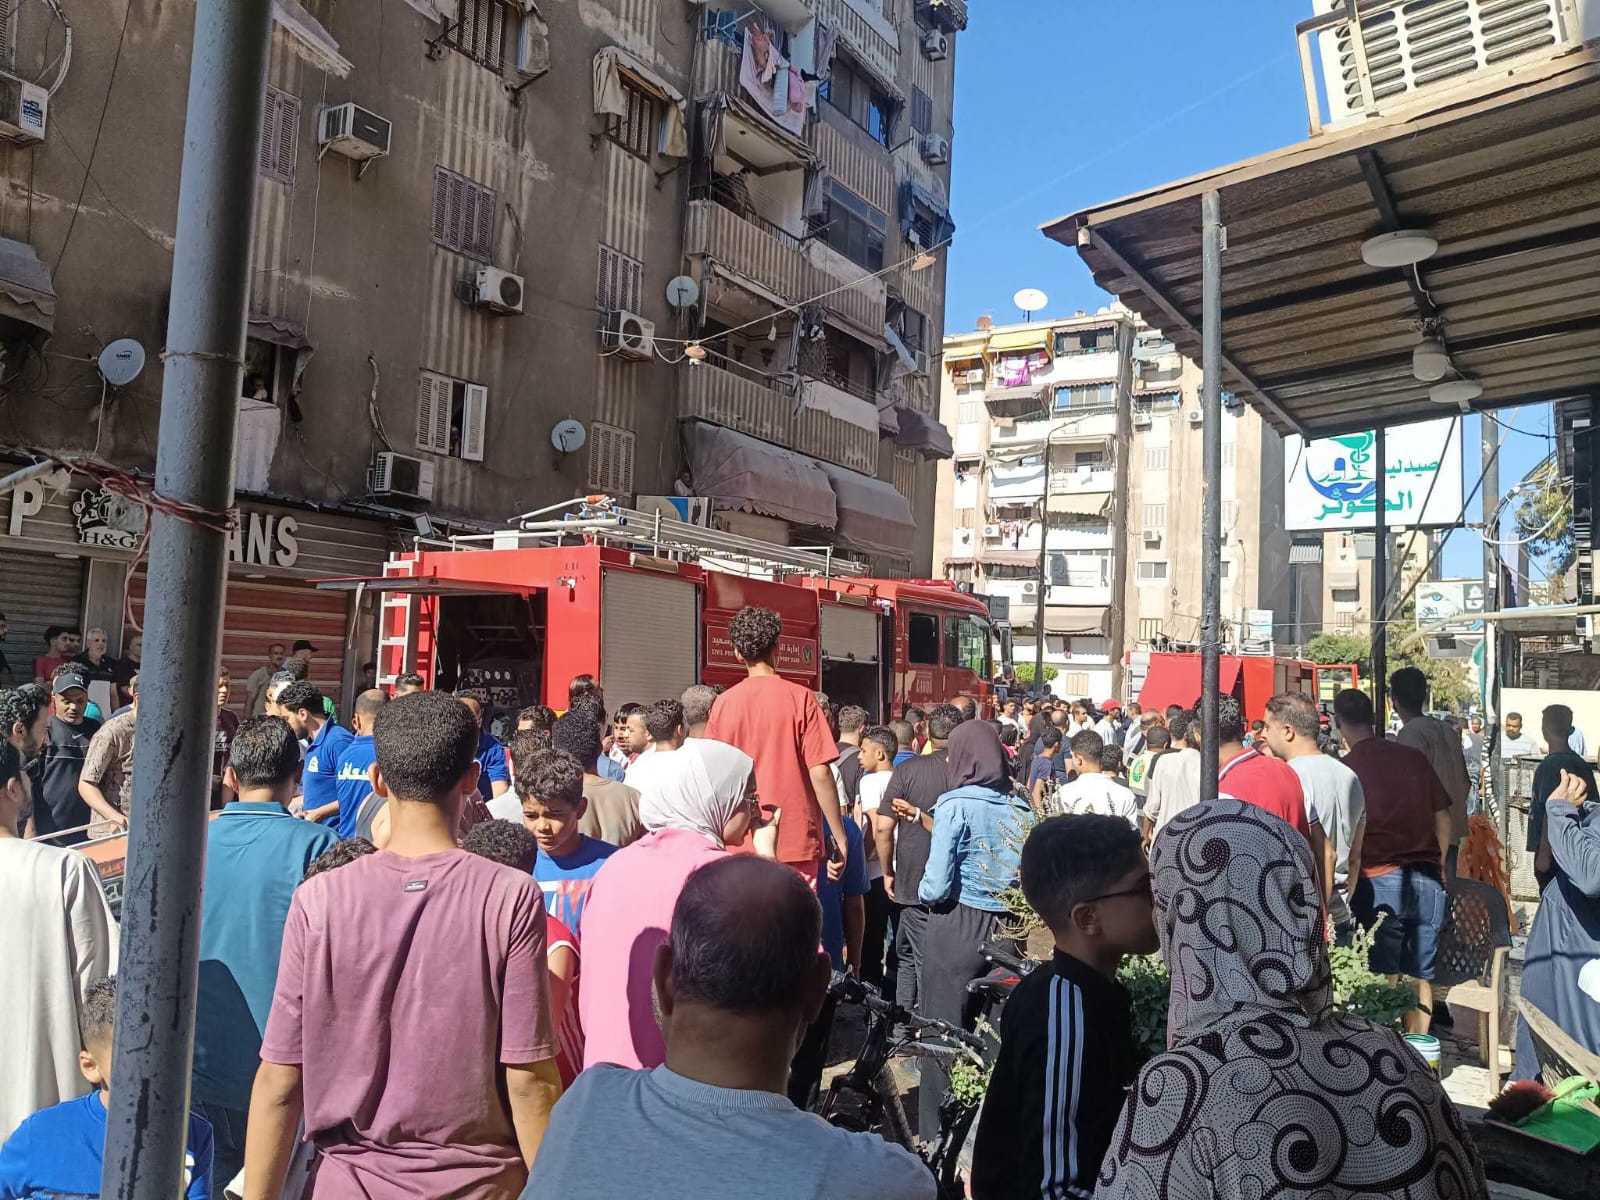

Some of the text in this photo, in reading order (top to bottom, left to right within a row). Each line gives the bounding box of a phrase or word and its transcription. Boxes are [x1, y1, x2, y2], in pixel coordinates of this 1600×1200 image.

[1385, 459, 1438, 479] صيدلي
[10, 479, 43, 536] P
[1313, 488, 1412, 520] الكوثر
[82, 531, 135, 549] H&G
[225, 508, 298, 567] ANS
[337, 762, 369, 780] سعاف
